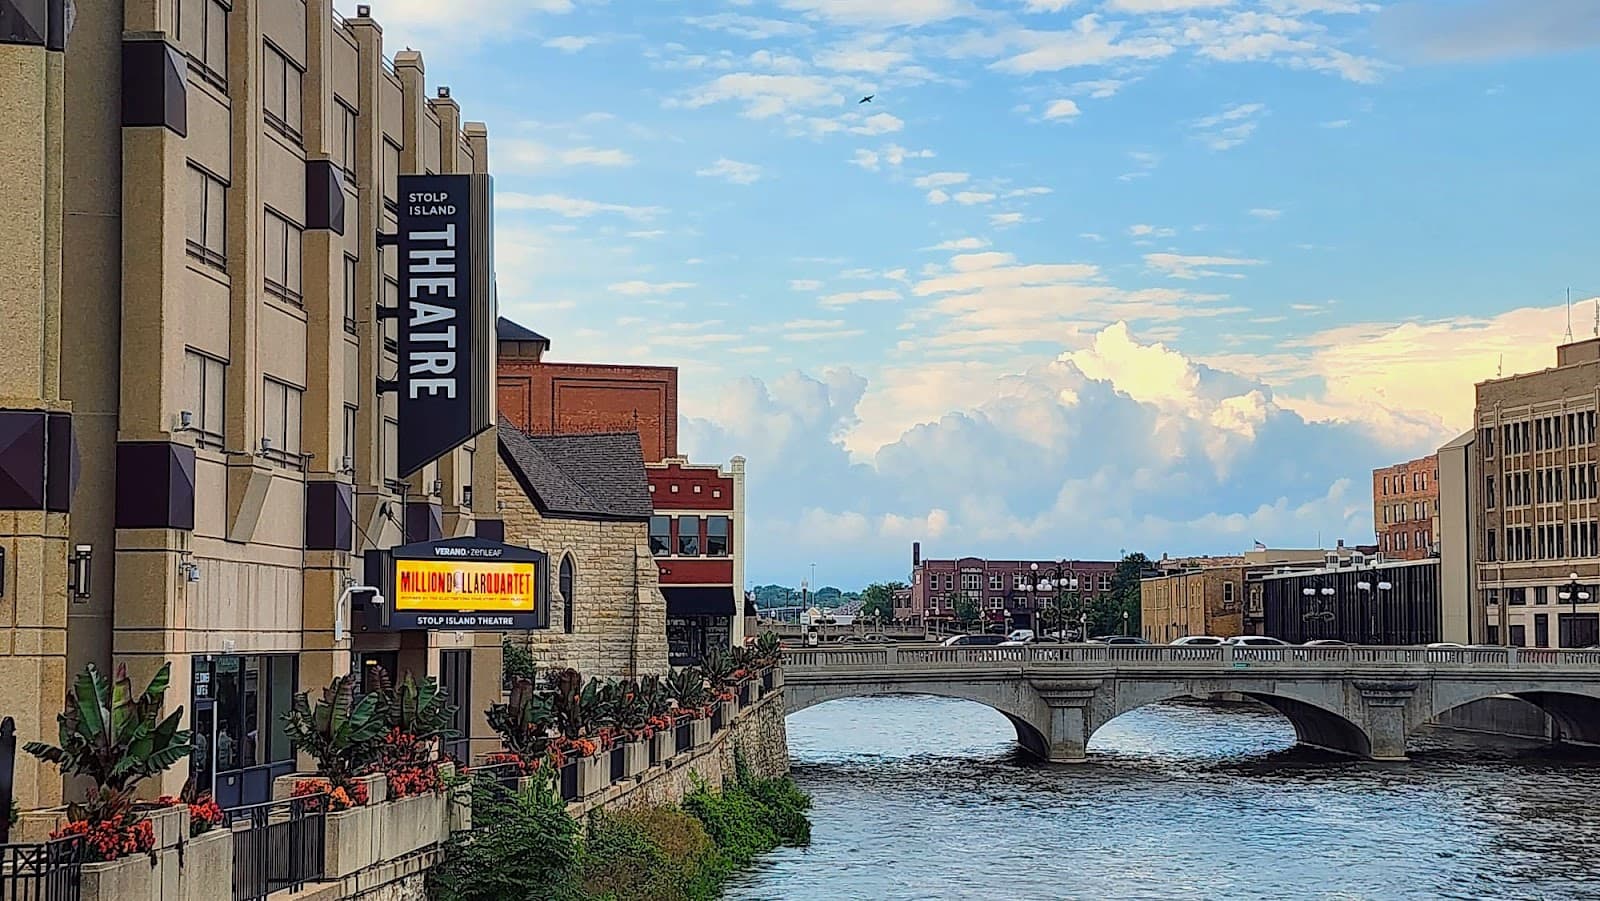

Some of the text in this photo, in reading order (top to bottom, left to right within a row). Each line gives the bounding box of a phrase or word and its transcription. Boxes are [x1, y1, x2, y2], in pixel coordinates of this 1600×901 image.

[408, 192, 448, 203] STOLP
[408, 205, 456, 216] ISLAND
[408, 223, 456, 399] THEATRE
[417, 616, 514, 625] STOLP ISLAND THEATRE
